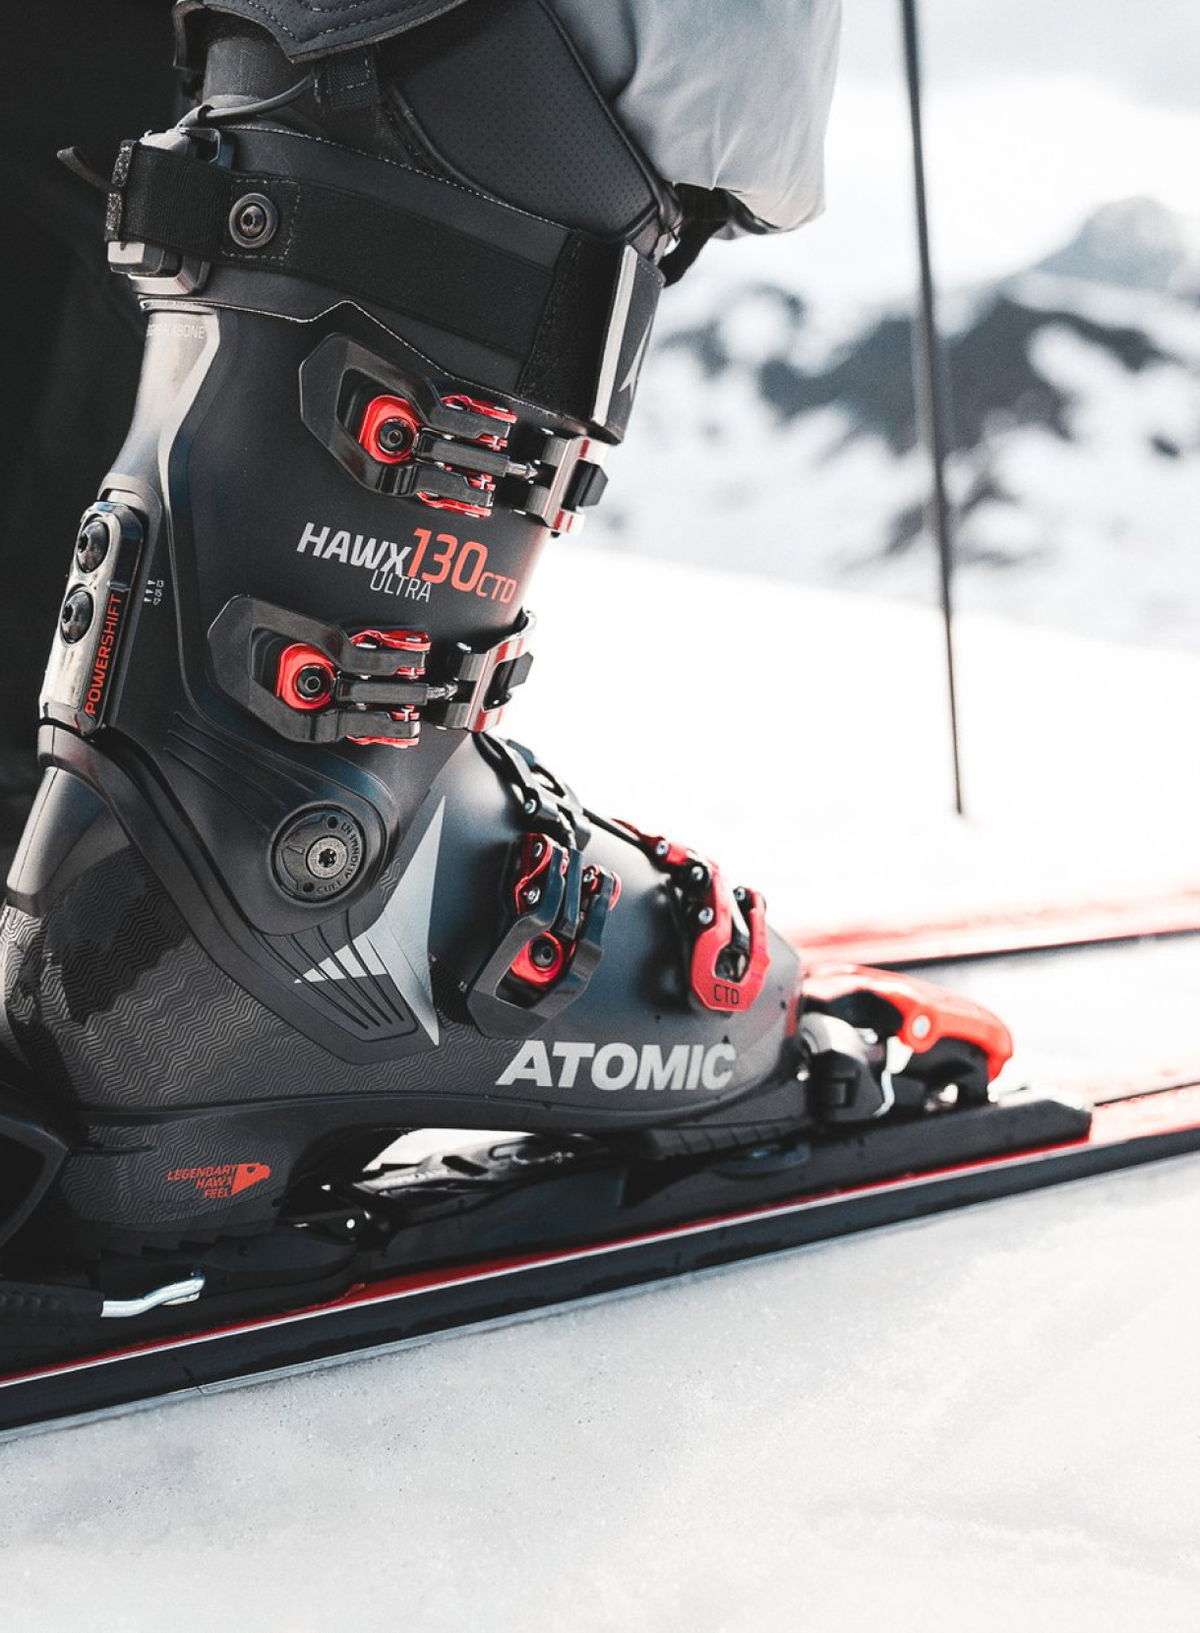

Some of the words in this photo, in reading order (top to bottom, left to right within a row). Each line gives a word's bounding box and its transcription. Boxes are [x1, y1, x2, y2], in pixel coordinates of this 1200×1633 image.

[296, 522, 412, 578] HAWX
[408, 527, 489, 592] 130
[475, 571, 518, 604] CTD
[370, 569, 431, 603] ULTRA
[84, 592, 122, 715] POWERSHIFT
[317, 879, 342, 892] CUFF
[340, 821, 360, 879] ALIGNMENT
[714, 983, 739, 1005] CTD
[495, 1039, 737, 1091] ATOMIC
[167, 1164, 237, 1182] LEGENDARY
[195, 1176, 232, 1190] HAWX
[204, 1188, 229, 1198] FEEL
